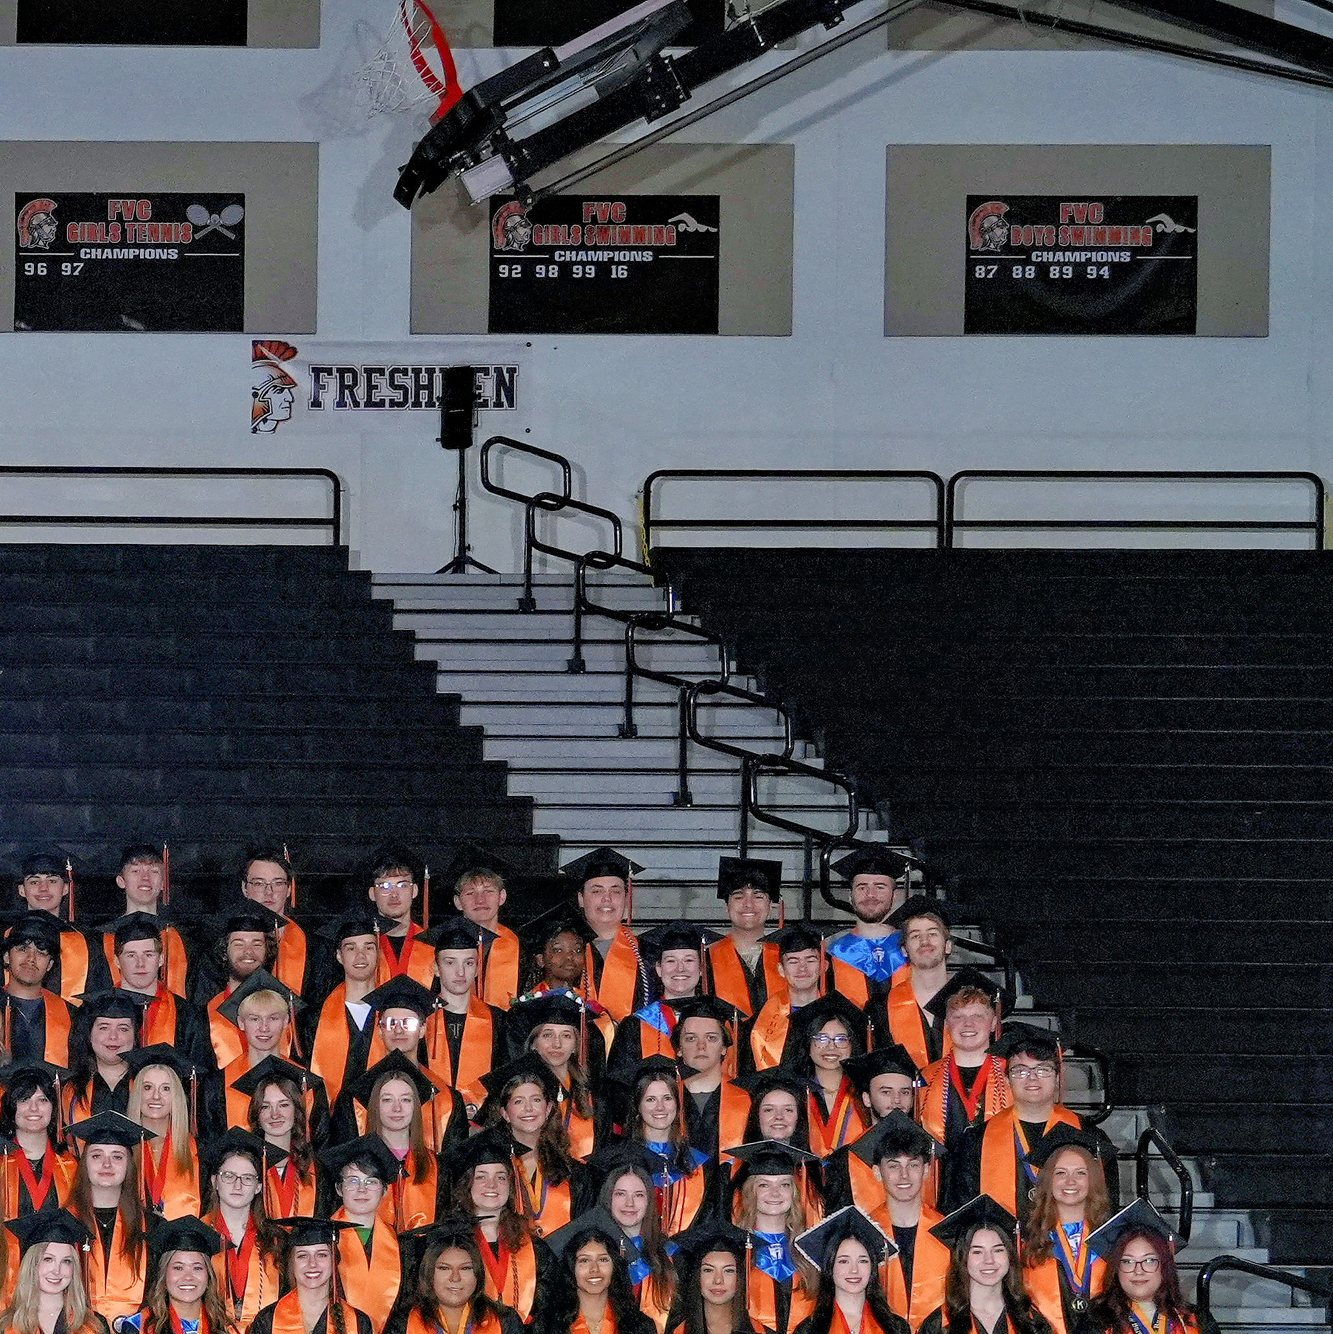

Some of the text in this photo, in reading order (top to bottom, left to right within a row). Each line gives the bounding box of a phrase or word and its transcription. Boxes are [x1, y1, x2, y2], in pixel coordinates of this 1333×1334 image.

[108, 200, 152, 221] FVC
[582, 202, 626, 223] FVC
[1060, 203, 1104, 223] FVC
[67, 222, 192, 244] GIRLS TENNIS
[533, 225, 676, 246] GIRLS SWIMMING
[1011, 225, 1152, 246] BOYS SWIMMING
[80, 248, 178, 259] CHAMPIONS
[554, 251, 653, 262] CHAMPIONS
[1032, 251, 1131, 262] CHAMPIONS
[24, 263, 84, 276] 96 97
[499, 265, 628, 278] 92 98 99 16
[975, 266, 1110, 279] 87 88 89 94
[308, 364, 518, 410] FRESHEN
